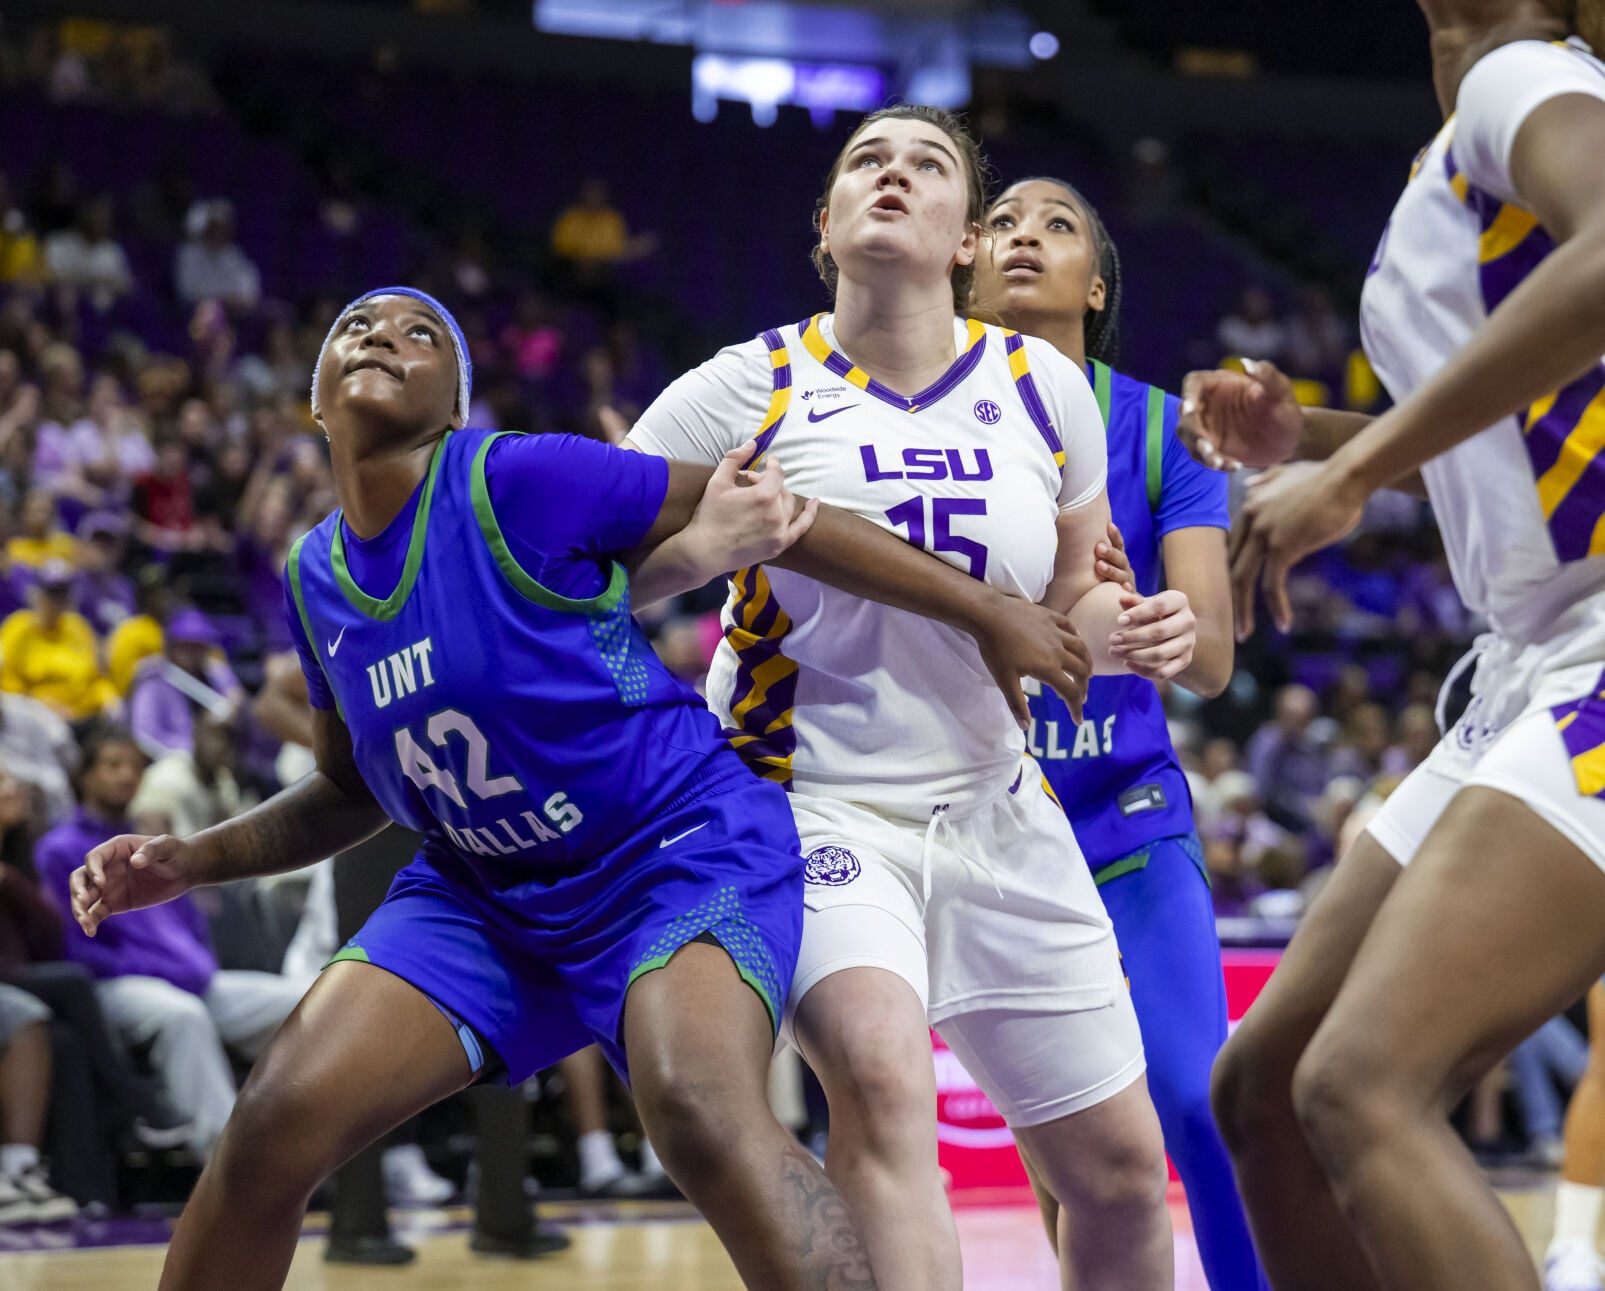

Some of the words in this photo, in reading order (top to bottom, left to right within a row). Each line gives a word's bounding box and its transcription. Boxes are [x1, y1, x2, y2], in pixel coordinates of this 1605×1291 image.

[815, 386, 847, 394] Woodside
[976, 401, 999, 422] SEC
[859, 444, 993, 482] LSU
[884, 495, 988, 582] 15
[366, 636, 436, 709] UNT
[394, 708, 524, 809] 42
